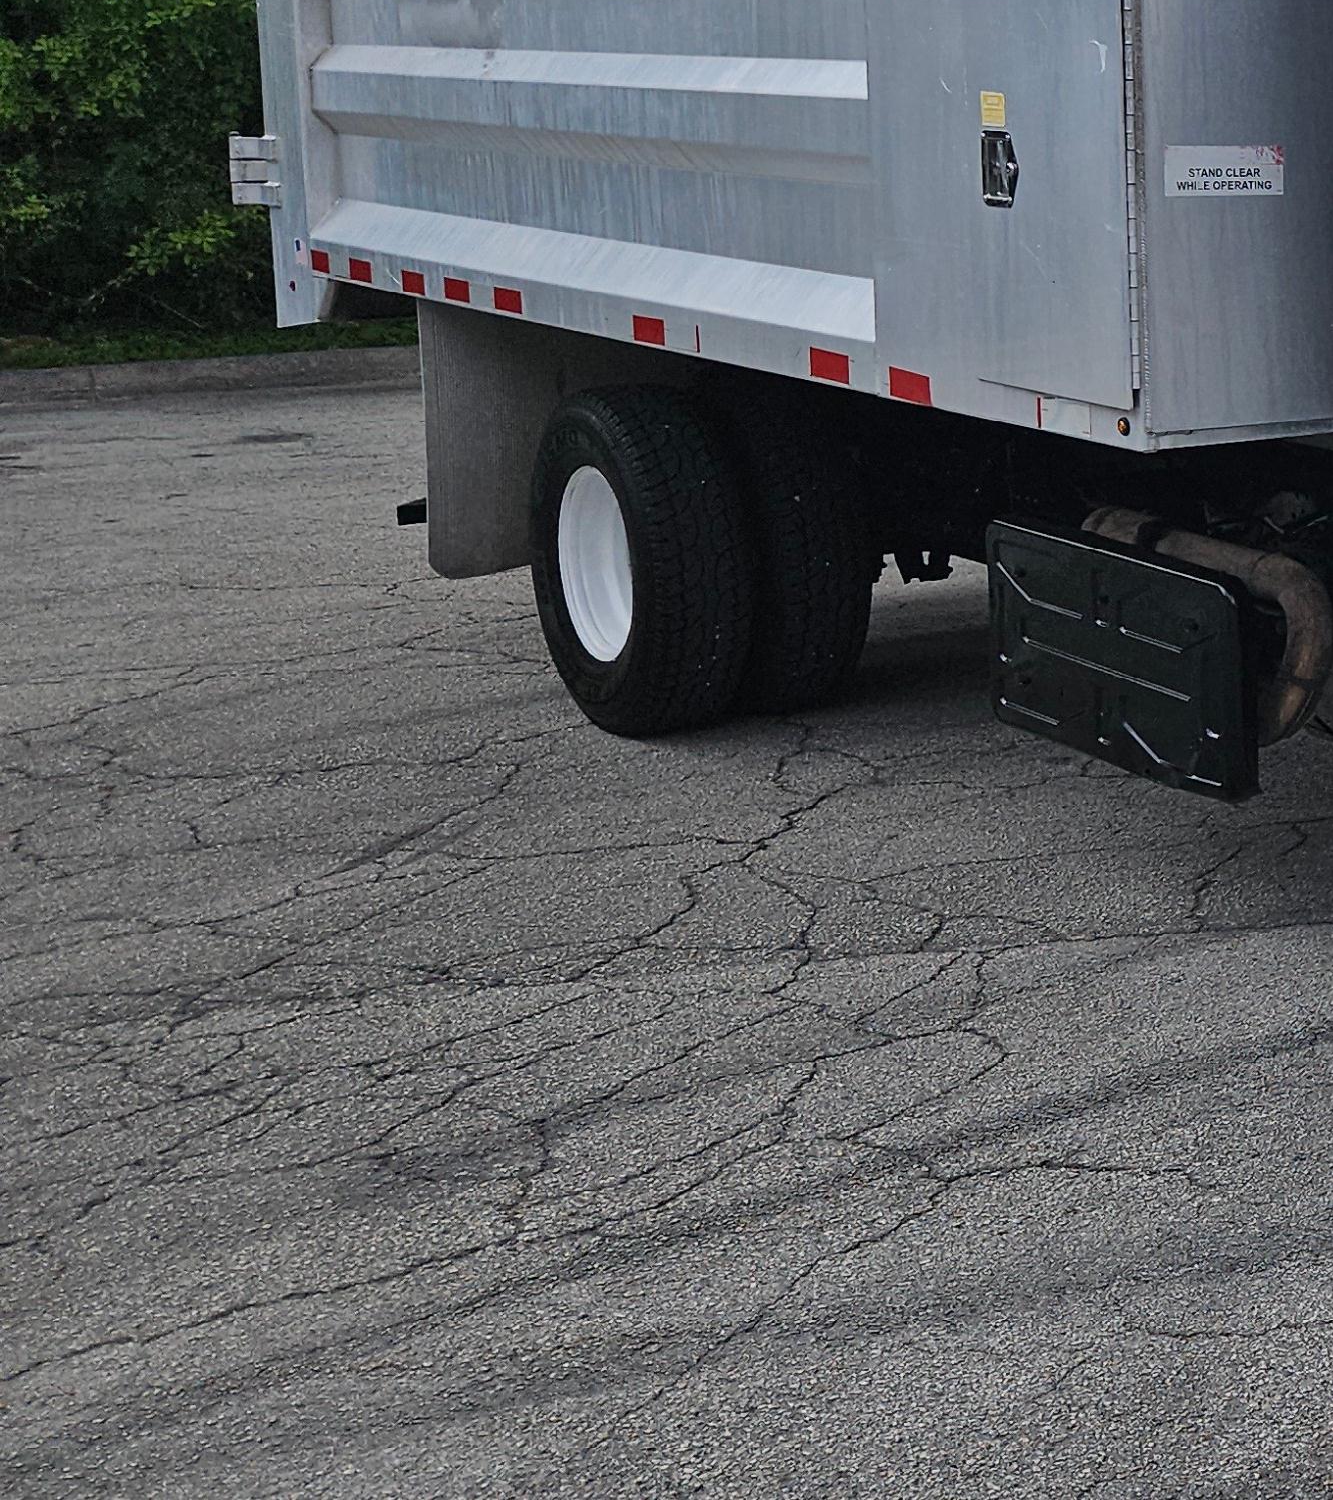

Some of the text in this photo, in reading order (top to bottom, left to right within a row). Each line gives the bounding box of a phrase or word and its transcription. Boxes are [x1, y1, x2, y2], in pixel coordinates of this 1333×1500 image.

[1188, 167, 1261, 178] STAND CLEAR
[1212, 180, 1273, 191] OPERATING
